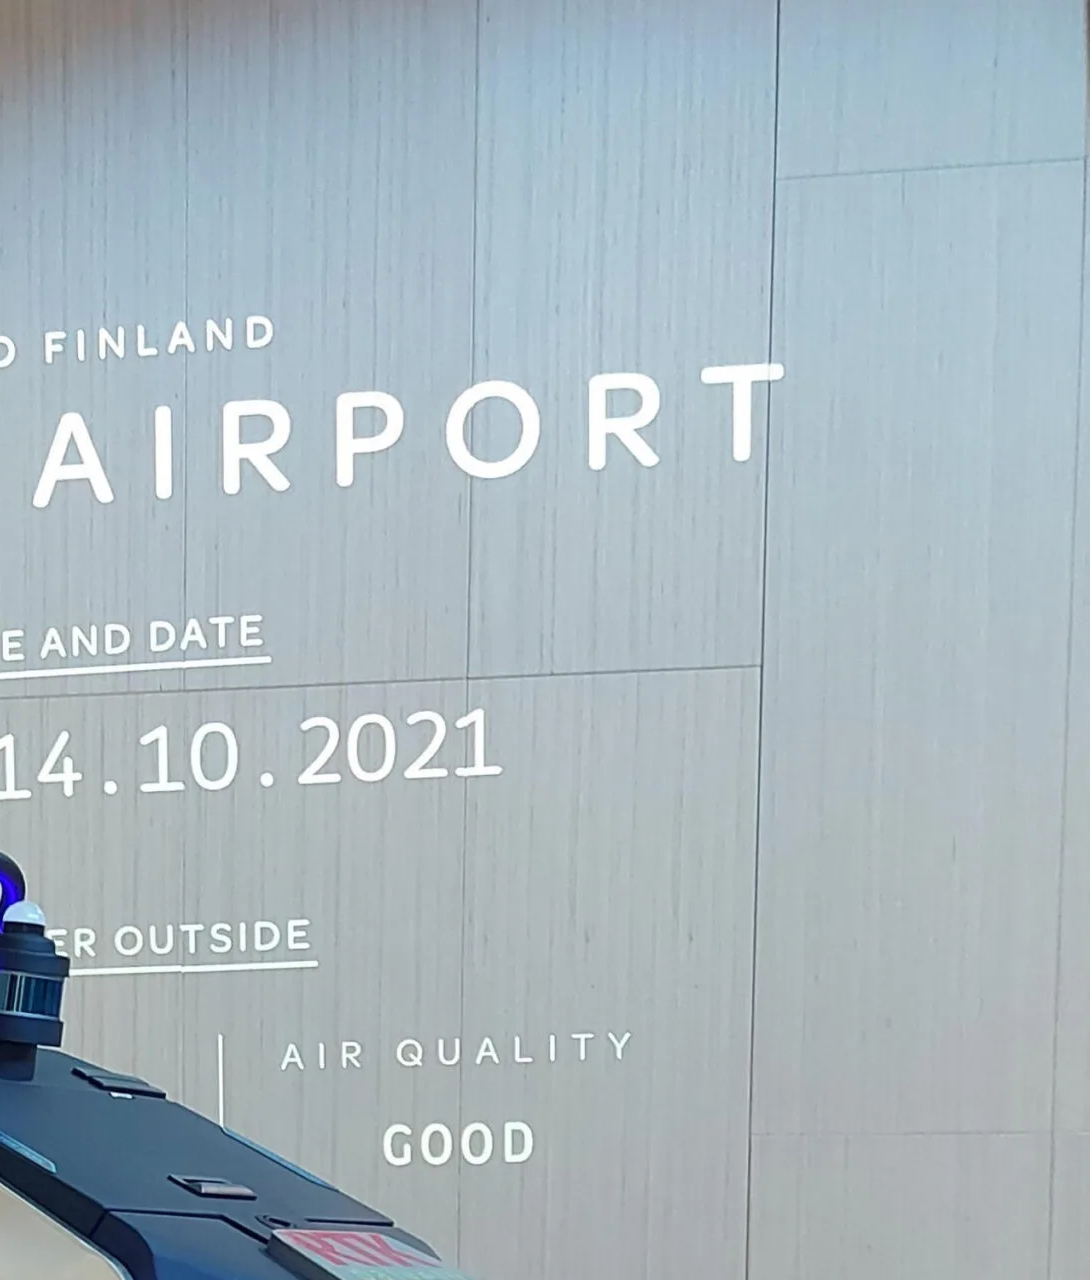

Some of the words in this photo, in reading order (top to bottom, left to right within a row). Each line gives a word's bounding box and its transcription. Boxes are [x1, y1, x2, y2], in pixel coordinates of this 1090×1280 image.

[44, 315, 275, 364] FINLAND
[32, 362, 785, 509] AIRPORT
[40, 623, 131, 660] AND
[149, 614, 264, 653] DATE
[114, 919, 311, 956] OUTSIDE
[280, 1041, 363, 1071] AIR
[396, 1031, 632, 1067] QUALITY
[382, 1121, 534, 1166] GOOD
[276, 1230, 442, 1267] RTK
